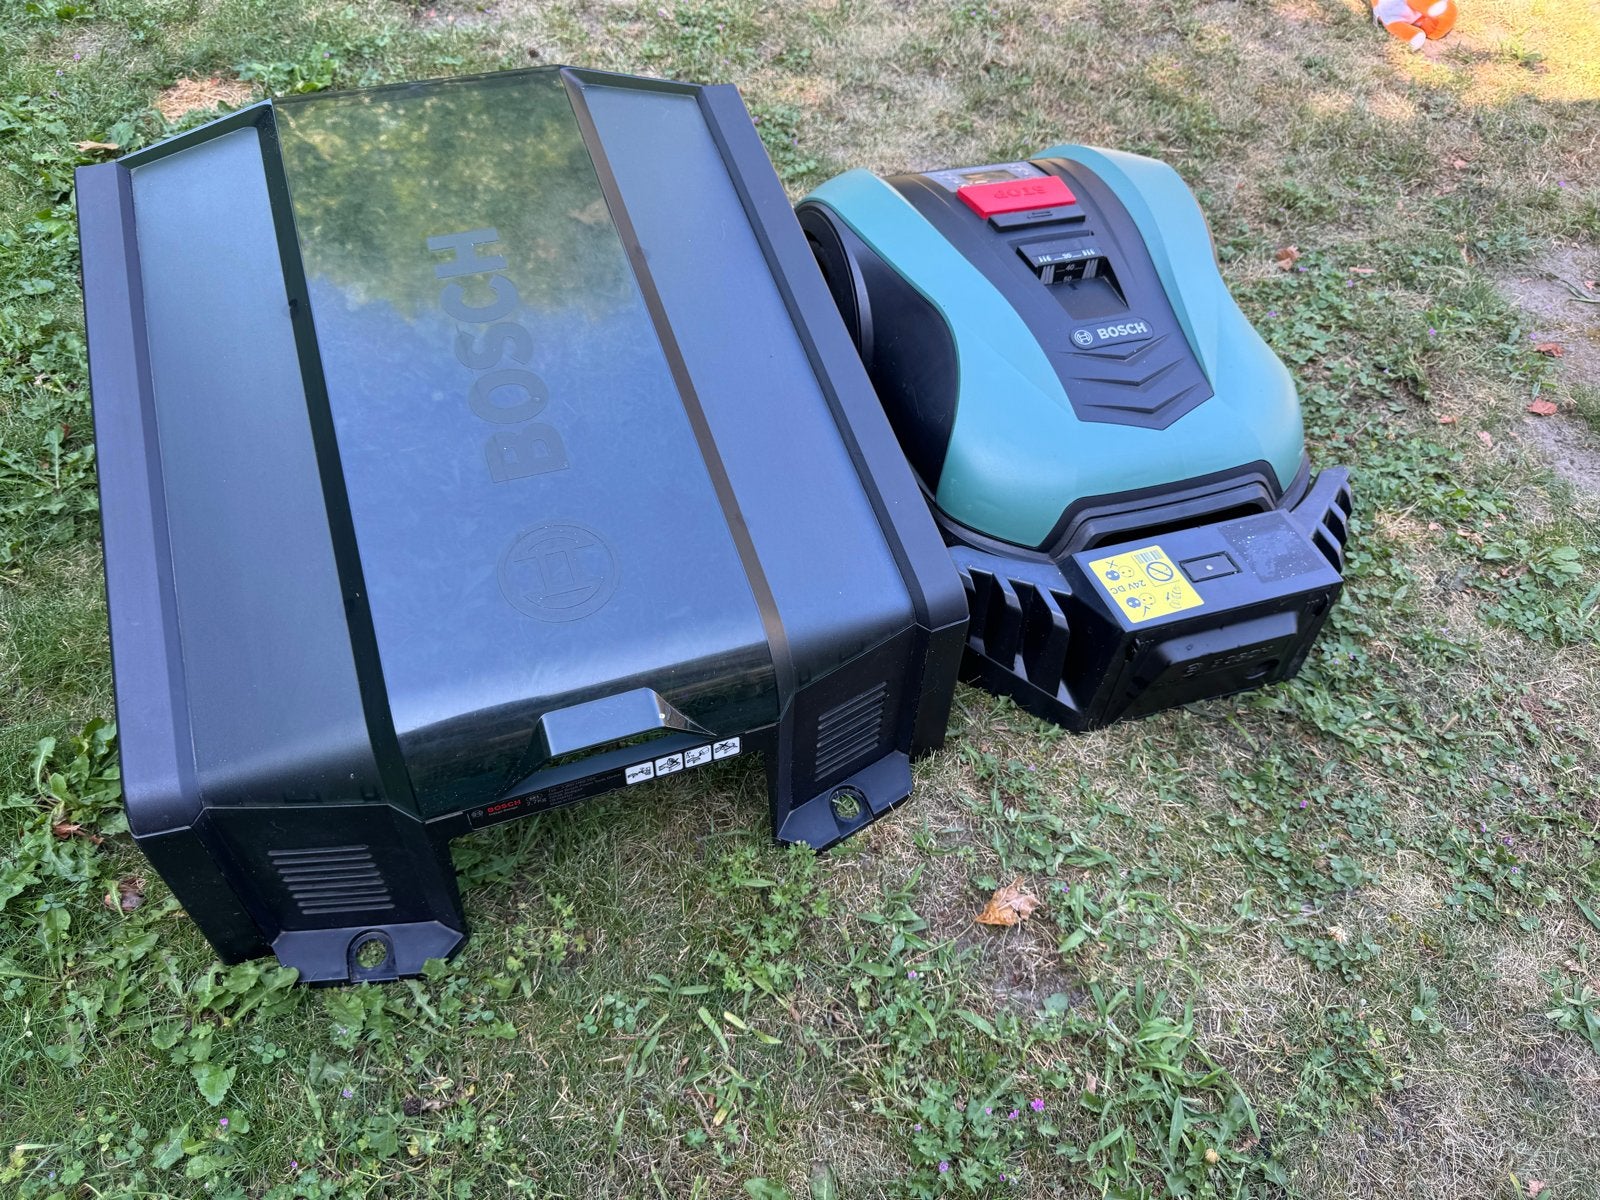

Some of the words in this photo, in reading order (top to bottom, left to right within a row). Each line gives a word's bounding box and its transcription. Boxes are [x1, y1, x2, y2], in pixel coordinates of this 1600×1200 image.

[994, 186, 1047, 199] STOP
[1096, 321, 1148, 340] BOSCH
[426, 227, 570, 483] BOSCH
[1110, 584, 1127, 595] DC
[1127, 579, 1147, 592] 24V
[487, 799, 521, 813] BOSCH
